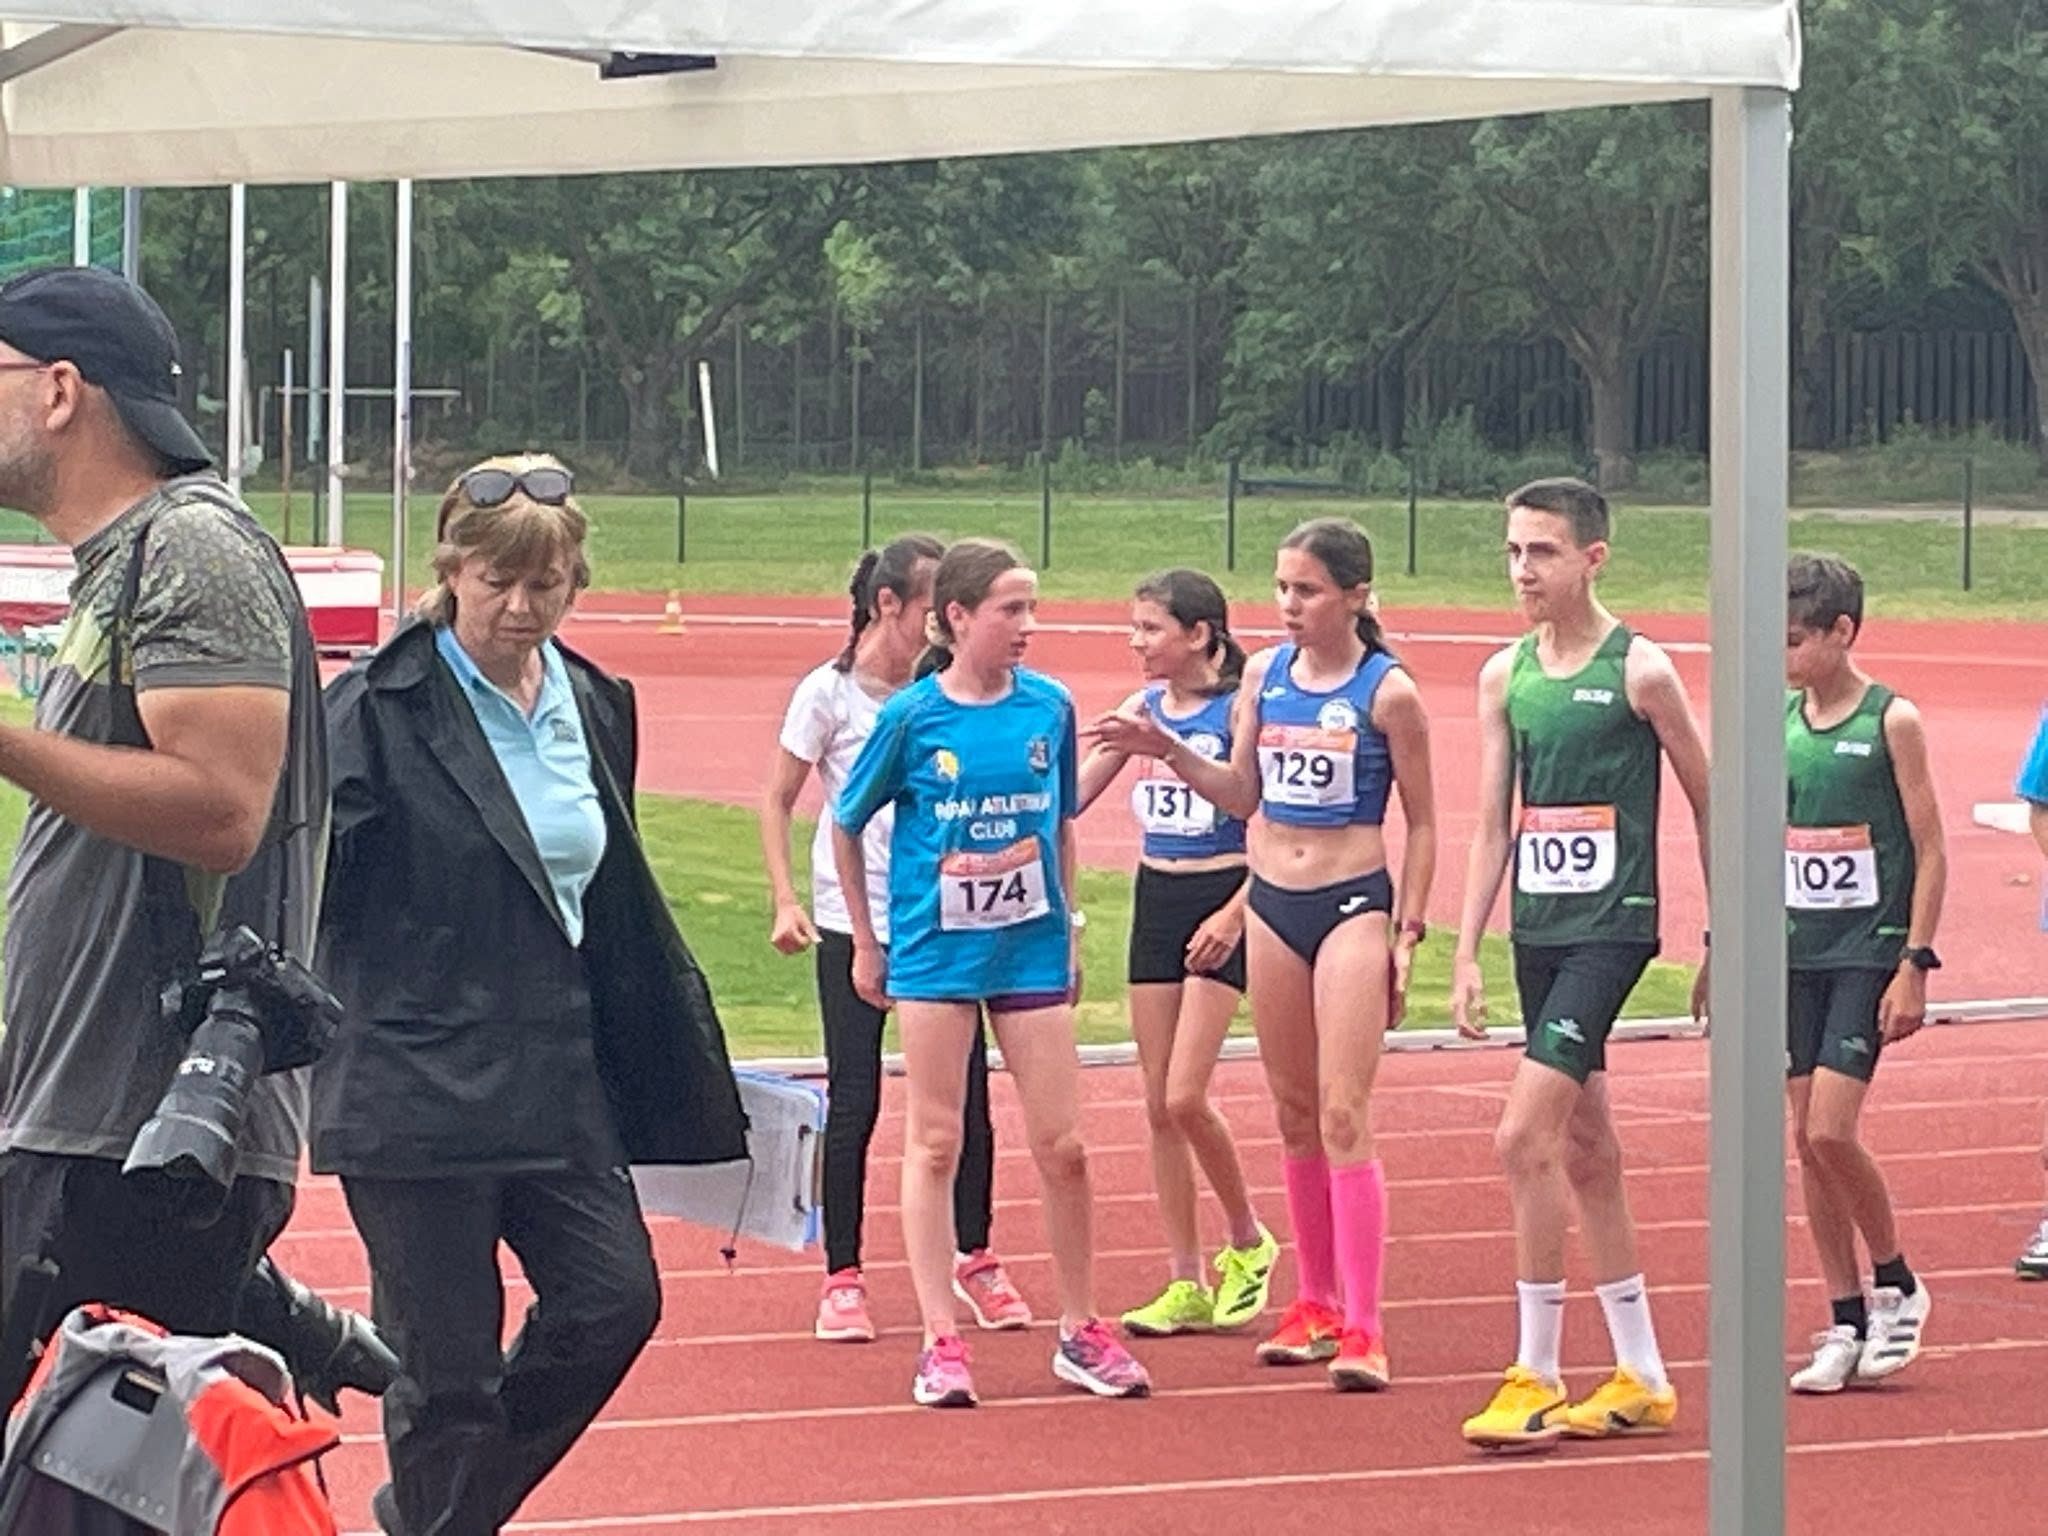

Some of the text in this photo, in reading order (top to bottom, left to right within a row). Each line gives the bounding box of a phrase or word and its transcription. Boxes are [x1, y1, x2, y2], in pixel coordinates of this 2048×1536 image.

[1272, 752, 1334, 789] 129
[1145, 785, 1193, 818] 131
[1529, 835, 1597, 874] 109
[1790, 856, 1859, 890] 102
[958, 870, 1027, 912] 174
